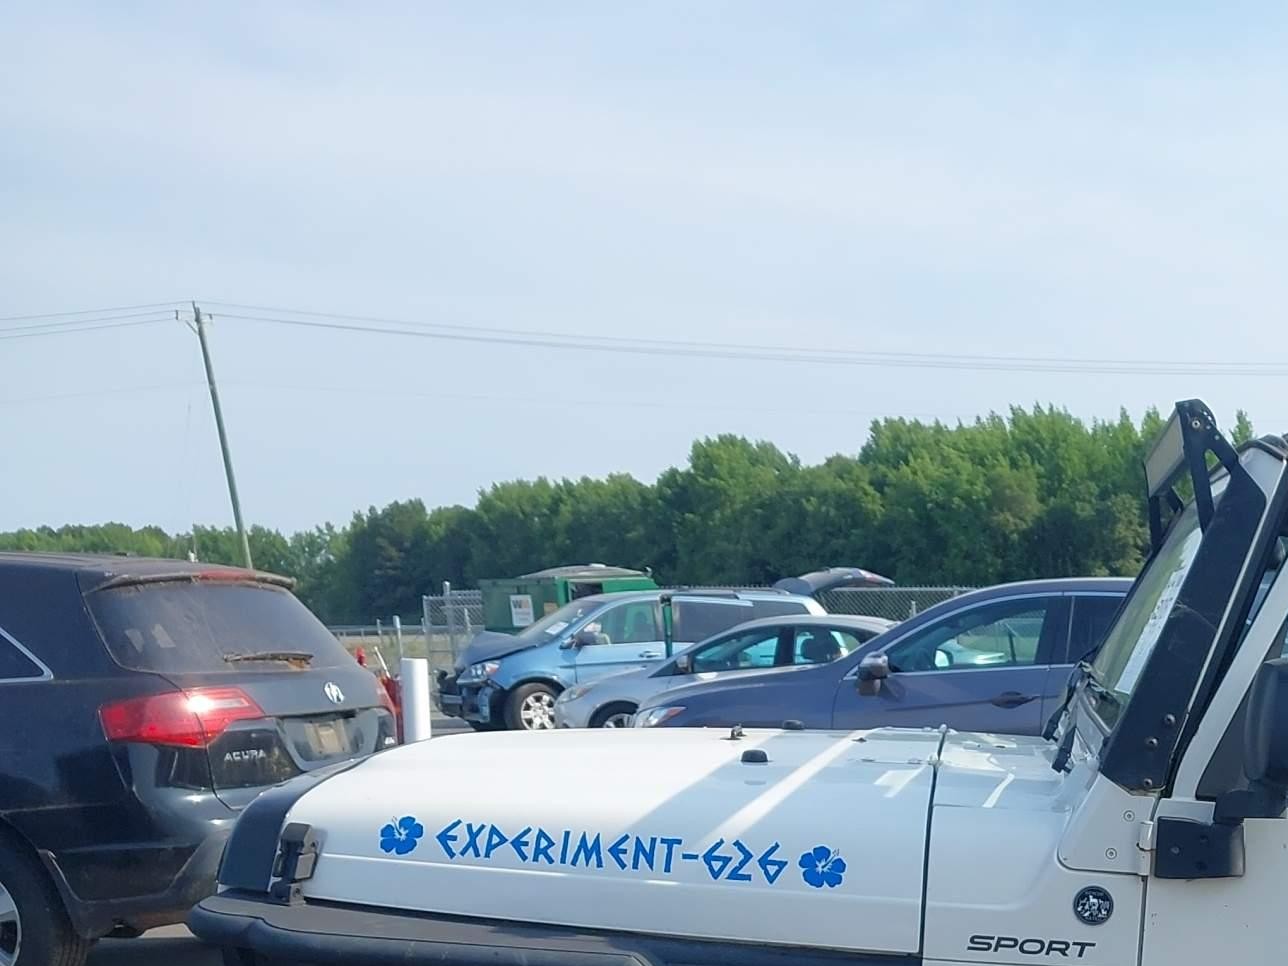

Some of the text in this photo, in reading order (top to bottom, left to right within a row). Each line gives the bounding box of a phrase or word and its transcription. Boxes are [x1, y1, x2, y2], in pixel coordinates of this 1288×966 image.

[224, 749, 267, 761] ACURA
[435, 818, 788, 884] EXPERIMENT-626
[966, 934, 1097, 958] SPORT
